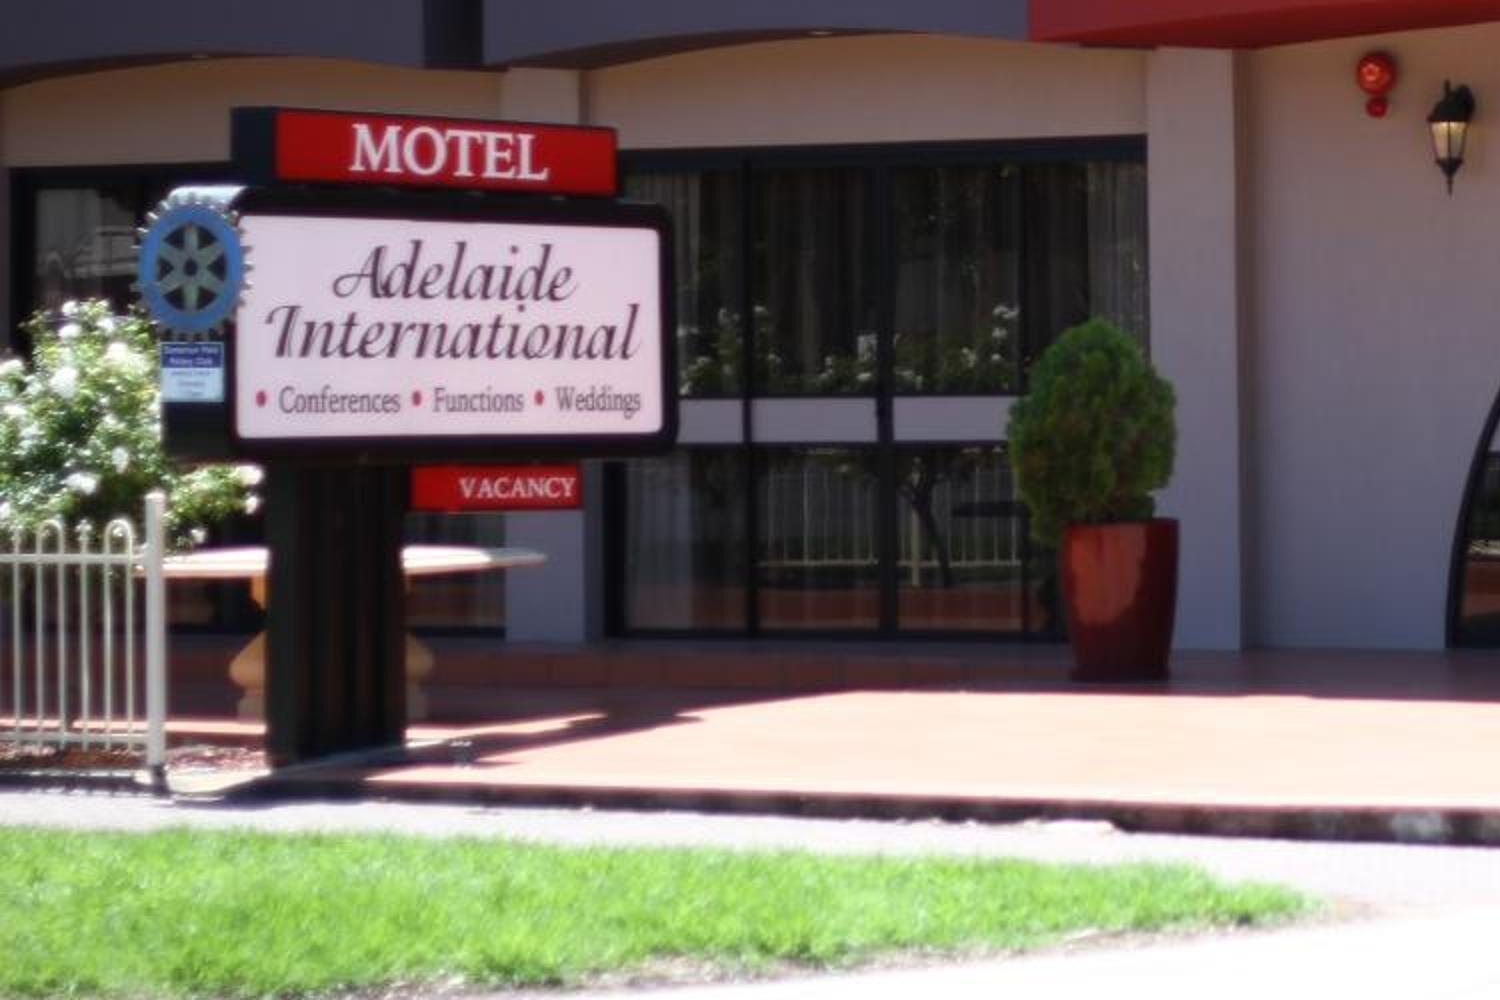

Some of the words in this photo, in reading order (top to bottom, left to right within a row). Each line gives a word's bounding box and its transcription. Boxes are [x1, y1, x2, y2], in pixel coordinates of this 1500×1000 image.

[348, 123, 549, 182] MOTEL
[332, 239, 577, 301] Adelaide
[265, 303, 641, 361] International
[278, 385, 401, 415] Conferences
[432, 386, 525, 414] Functions
[555, 386, 641, 420] Weddings
[459, 476, 576, 500] VACANCY
